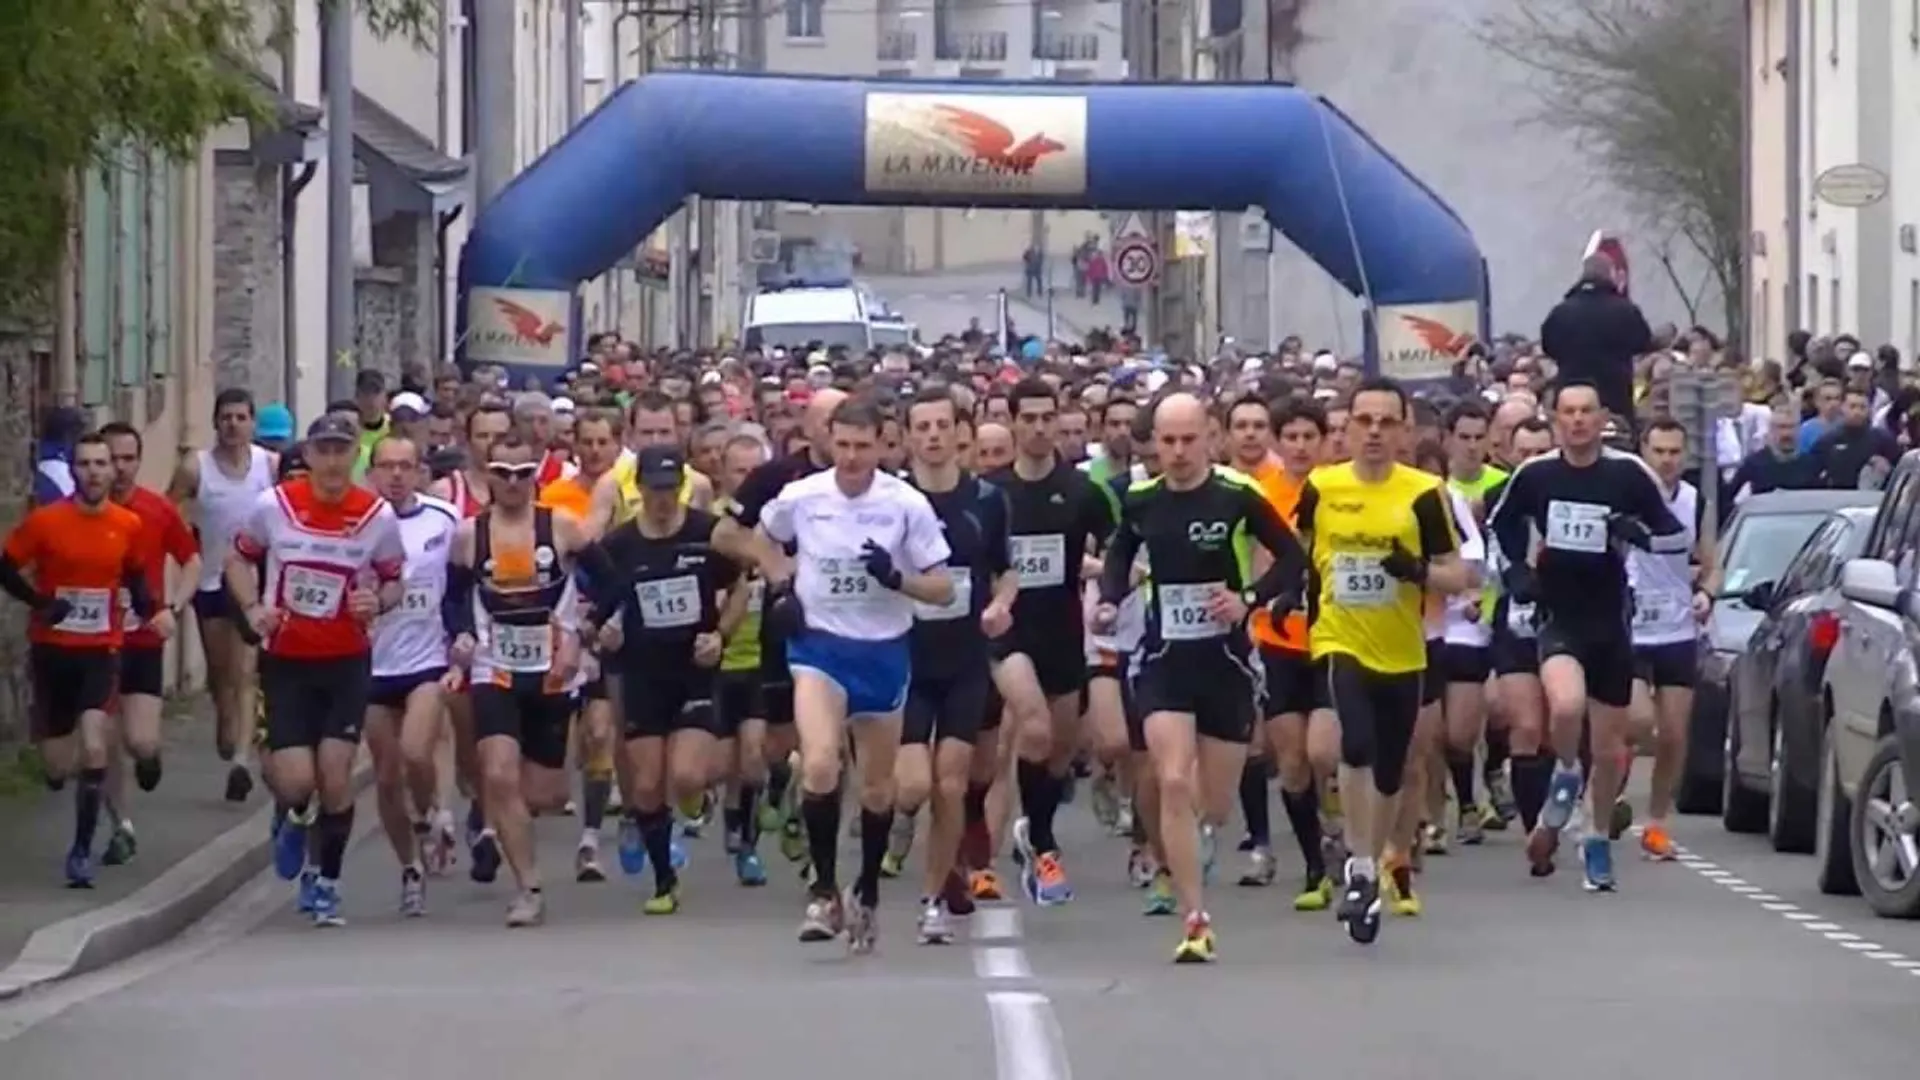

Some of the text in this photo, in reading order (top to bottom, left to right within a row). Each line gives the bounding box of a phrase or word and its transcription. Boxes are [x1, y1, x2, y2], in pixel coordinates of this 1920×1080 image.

[883, 152, 1033, 175] LA MAYENNE
[1126, 255, 1147, 274] 30
[1562, 521, 1594, 539] 117
[830, 576, 868, 594] 259
[1347, 574, 1386, 591] 539
[655, 597, 688, 615] 115
